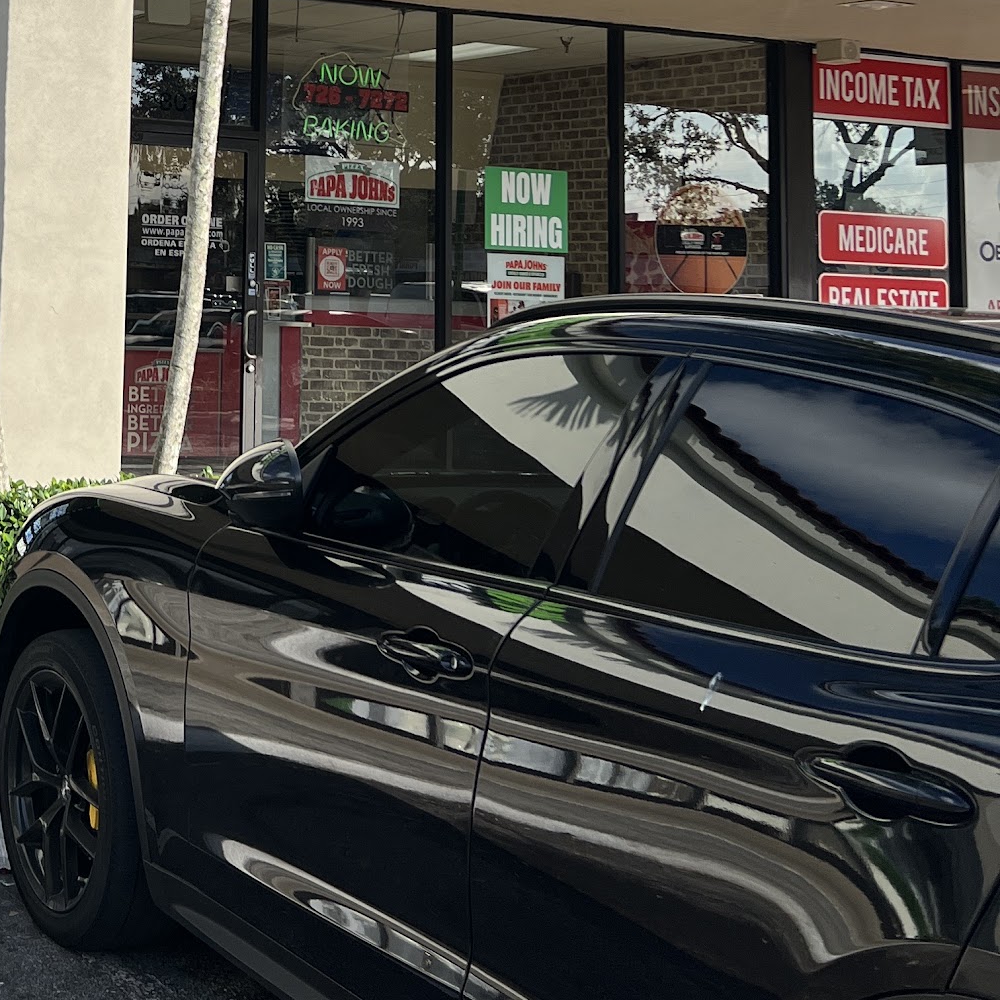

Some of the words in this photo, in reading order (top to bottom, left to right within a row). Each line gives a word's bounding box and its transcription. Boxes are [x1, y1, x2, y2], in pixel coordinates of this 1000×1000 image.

[320, 62, 382, 88] NOW
[819, 68, 900, 107] INCOME
[902, 76, 941, 110] TAX
[303, 115, 390, 143] BAKING
[309, 174, 347, 199] PAPA
[349, 174, 396, 203] JOHNS
[501, 171, 552, 206] NOW
[306, 204, 332, 213] LOCAL
[333, 204, 375, 216] OWNERSHIP
[376, 208, 398, 218] SINCE
[141, 213, 179, 226] ORDER
[341, 216, 365, 228] 1993
[490, 213, 563, 250] HIRING
[140, 237, 177, 247] ORDENA
[838, 223, 929, 256] MEDICARE
[154, 248, 167, 257] EN
[322, 247, 343, 256] APPLY
[348, 249, 394, 264] BETTER
[505, 260, 523, 269] PAPA
[523, 260, 547, 271] JOHNS
[323, 281, 342, 289] NOW
[347, 277, 394, 290] DOUGH
[491, 280, 512, 289] JOIN
[513, 281, 531, 290] OUR
[532, 281, 561, 292] FAMILY
[136, 366, 159, 383] PAPA
[128, 386, 167, 402] BET
